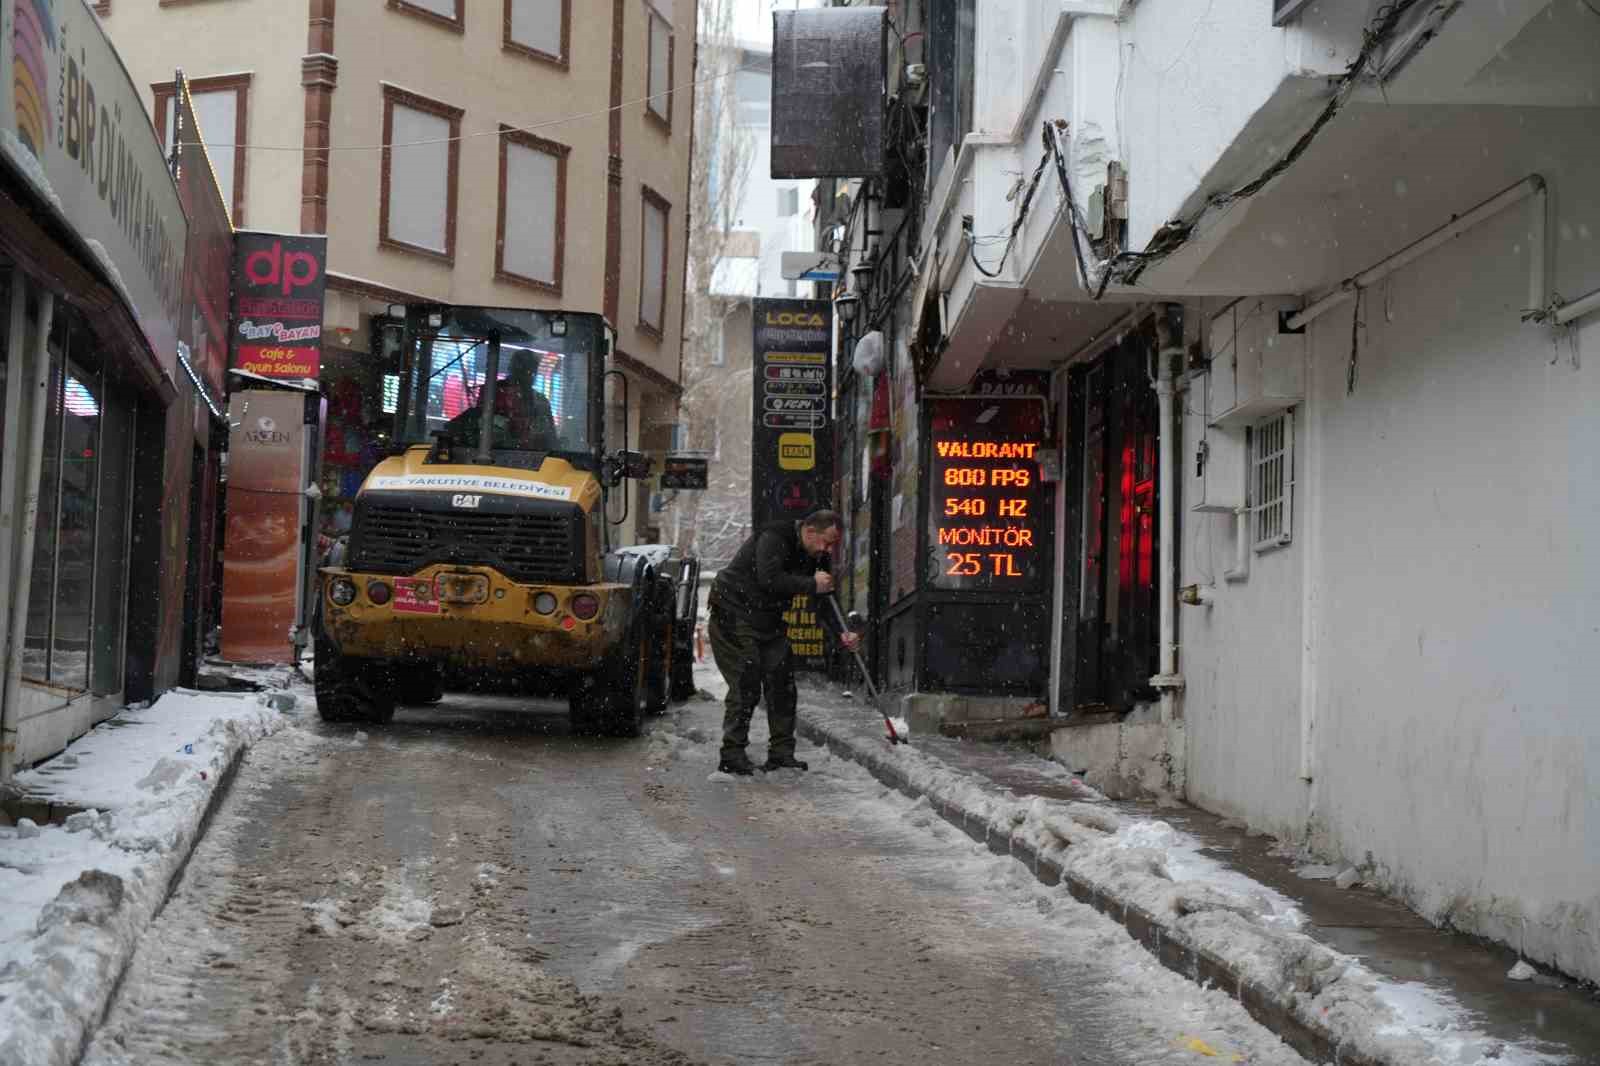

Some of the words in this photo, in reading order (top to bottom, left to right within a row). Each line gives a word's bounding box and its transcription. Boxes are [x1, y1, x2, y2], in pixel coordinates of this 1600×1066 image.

[66, 47, 96, 184] BİR
[245, 240, 319, 295] dp
[766, 312, 824, 326] LOCA
[278, 325, 320, 342] BAYAN
[259, 348, 284, 360] Cafe
[275, 361, 311, 374] Salonu
[937, 441, 1035, 459] VALORANT
[991, 469, 1030, 487] FPS
[483, 481, 566, 497] BELEDİYESİ
[451, 494, 482, 508] CAT
[945, 499, 985, 516] 540
[999, 499, 1028, 517] HZ
[939, 525, 1033, 546] MONİTÖR
[946, 553, 981, 575] 25
[989, 553, 1023, 576] TL
